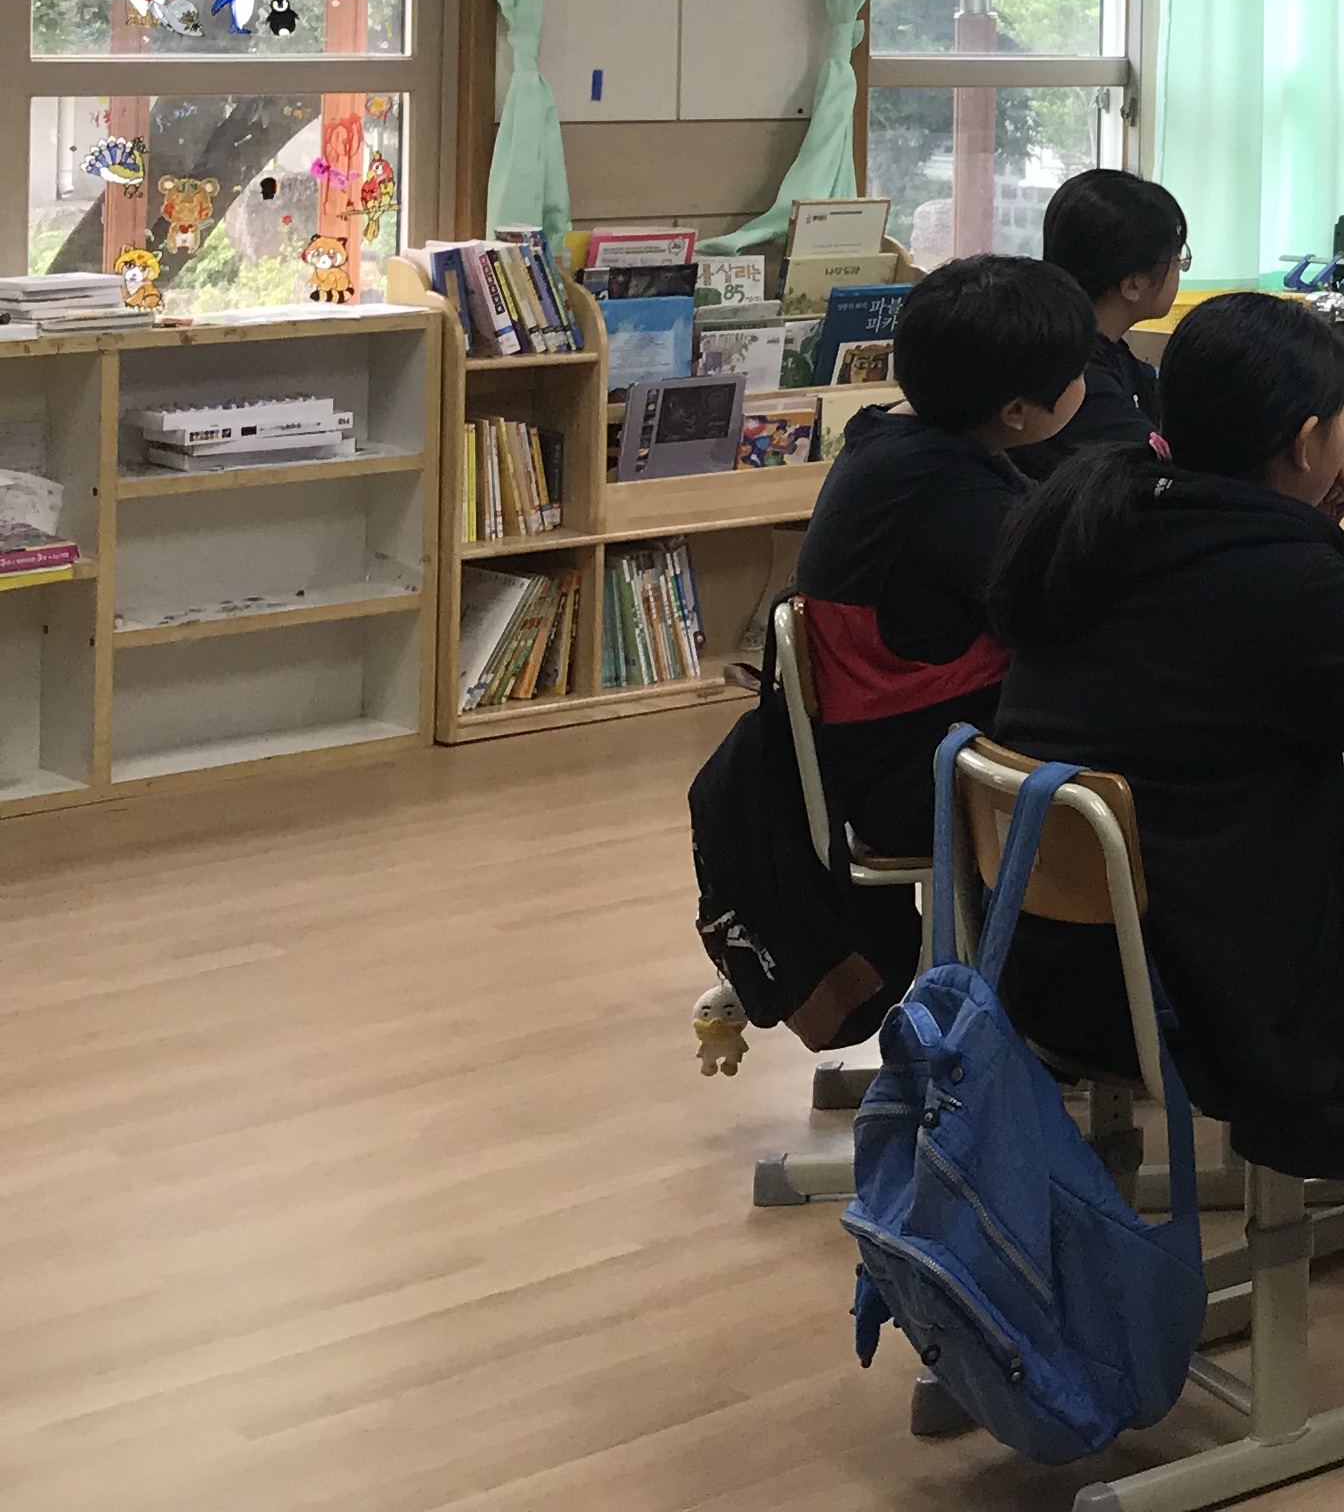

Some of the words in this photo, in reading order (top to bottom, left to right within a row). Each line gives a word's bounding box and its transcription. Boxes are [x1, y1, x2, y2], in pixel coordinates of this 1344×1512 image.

[715, 262, 762, 284] 살리는
[723, 283, 746, 304] 85
[868, 296, 904, 315] 파블
[865, 314, 899, 334] 피카
